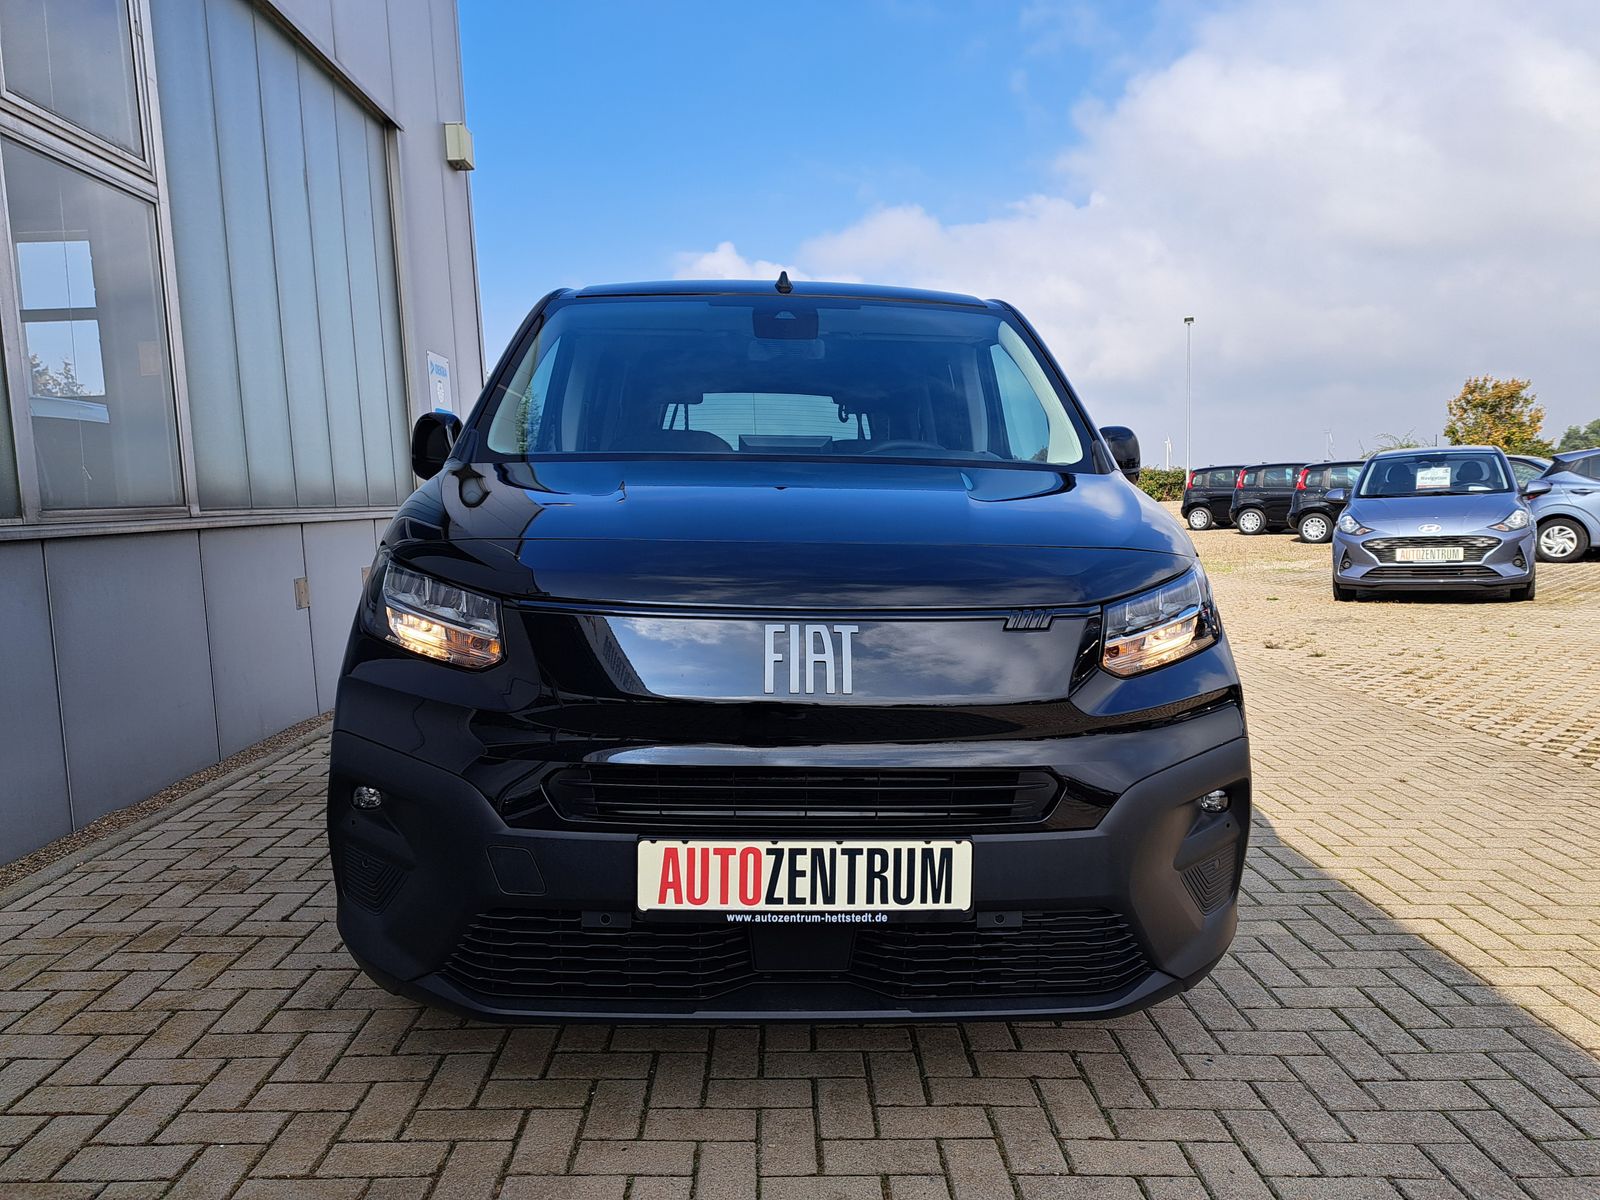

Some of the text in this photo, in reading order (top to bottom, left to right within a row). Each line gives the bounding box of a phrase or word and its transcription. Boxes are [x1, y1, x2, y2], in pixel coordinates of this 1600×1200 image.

[1400, 548, 1460, 560] AUTOZENTRUM
[764, 624, 859, 694] FIAT
[657, 846, 953, 906] AUTOZENTRUM
[726, 912, 888, 923] www.autozentrum-hettstedt.de
